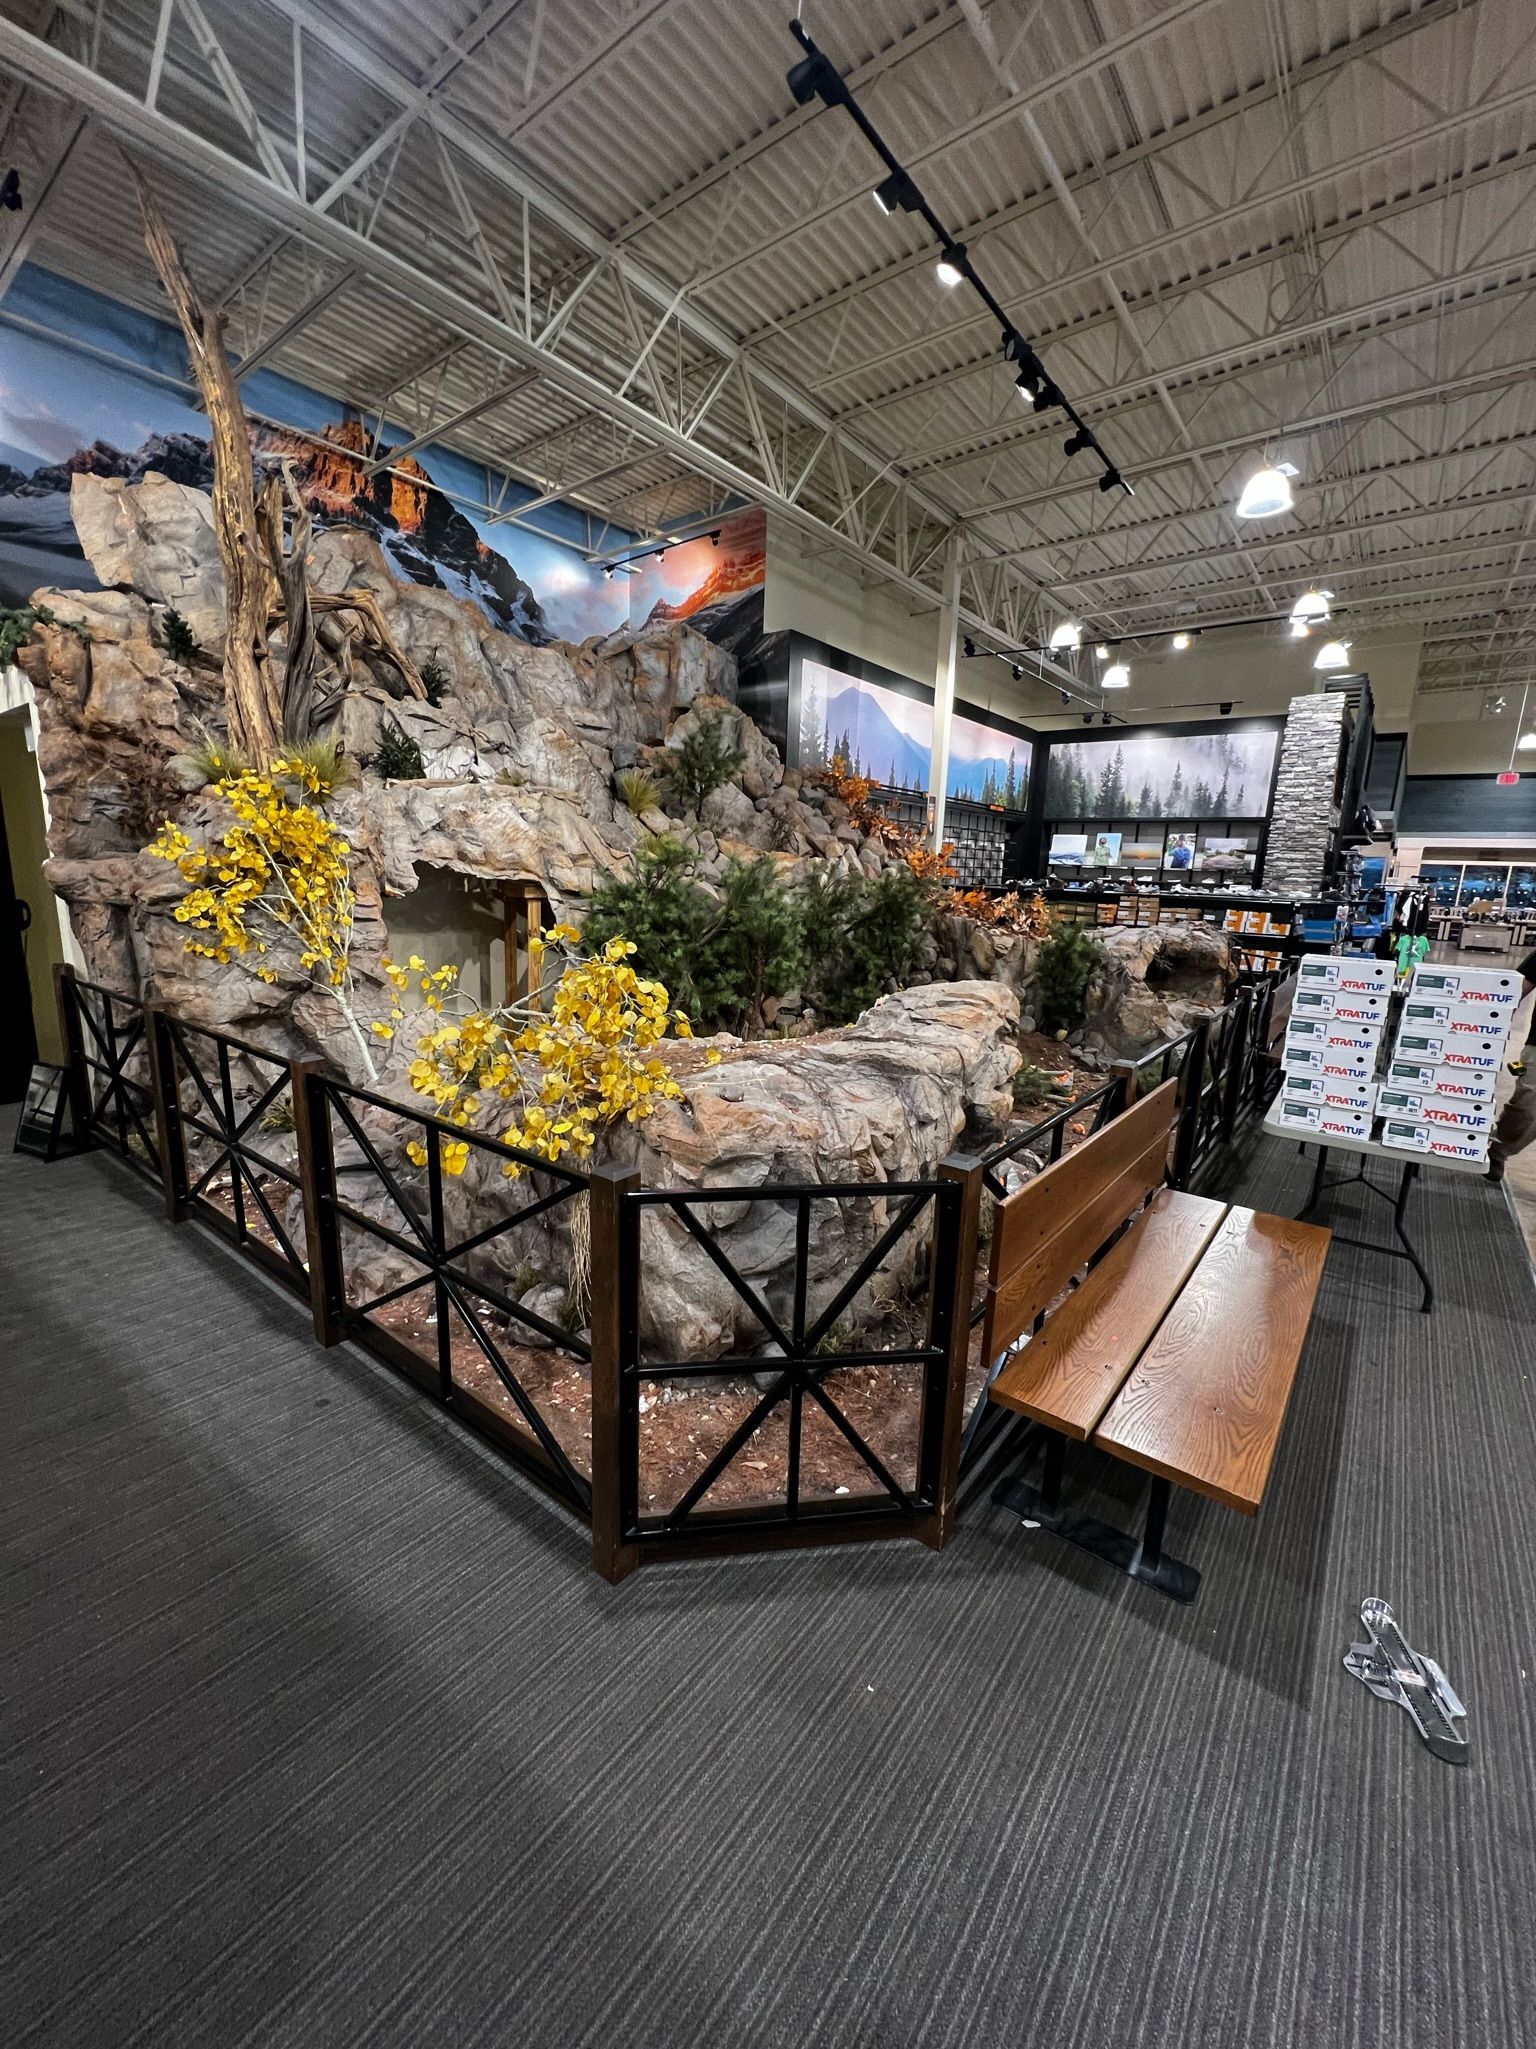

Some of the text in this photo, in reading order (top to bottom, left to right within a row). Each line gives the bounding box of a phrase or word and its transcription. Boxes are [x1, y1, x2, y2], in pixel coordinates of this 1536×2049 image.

[1340, 980, 1386, 991] XTRATUF
[1461, 991, 1513, 1002] XTRATUF
[1335, 1008, 1380, 1020] XTRATUF
[1450, 1022, 1502, 1034] XTRATUF
[1328, 1037, 1373, 1048] XTRATUF
[1444, 1054, 1495, 1066] XTRATUF
[1323, 1065, 1367, 1078] XTRATUF
[1435, 1083, 1486, 1096] XTRATUF
[1325, 1094, 1368, 1107] XTRATUF
[1423, 1109, 1486, 1126] XTRATUF
[1322, 1122, 1366, 1135] XTRATUF
[1430, 1142, 1480, 1157] XTRATUF
